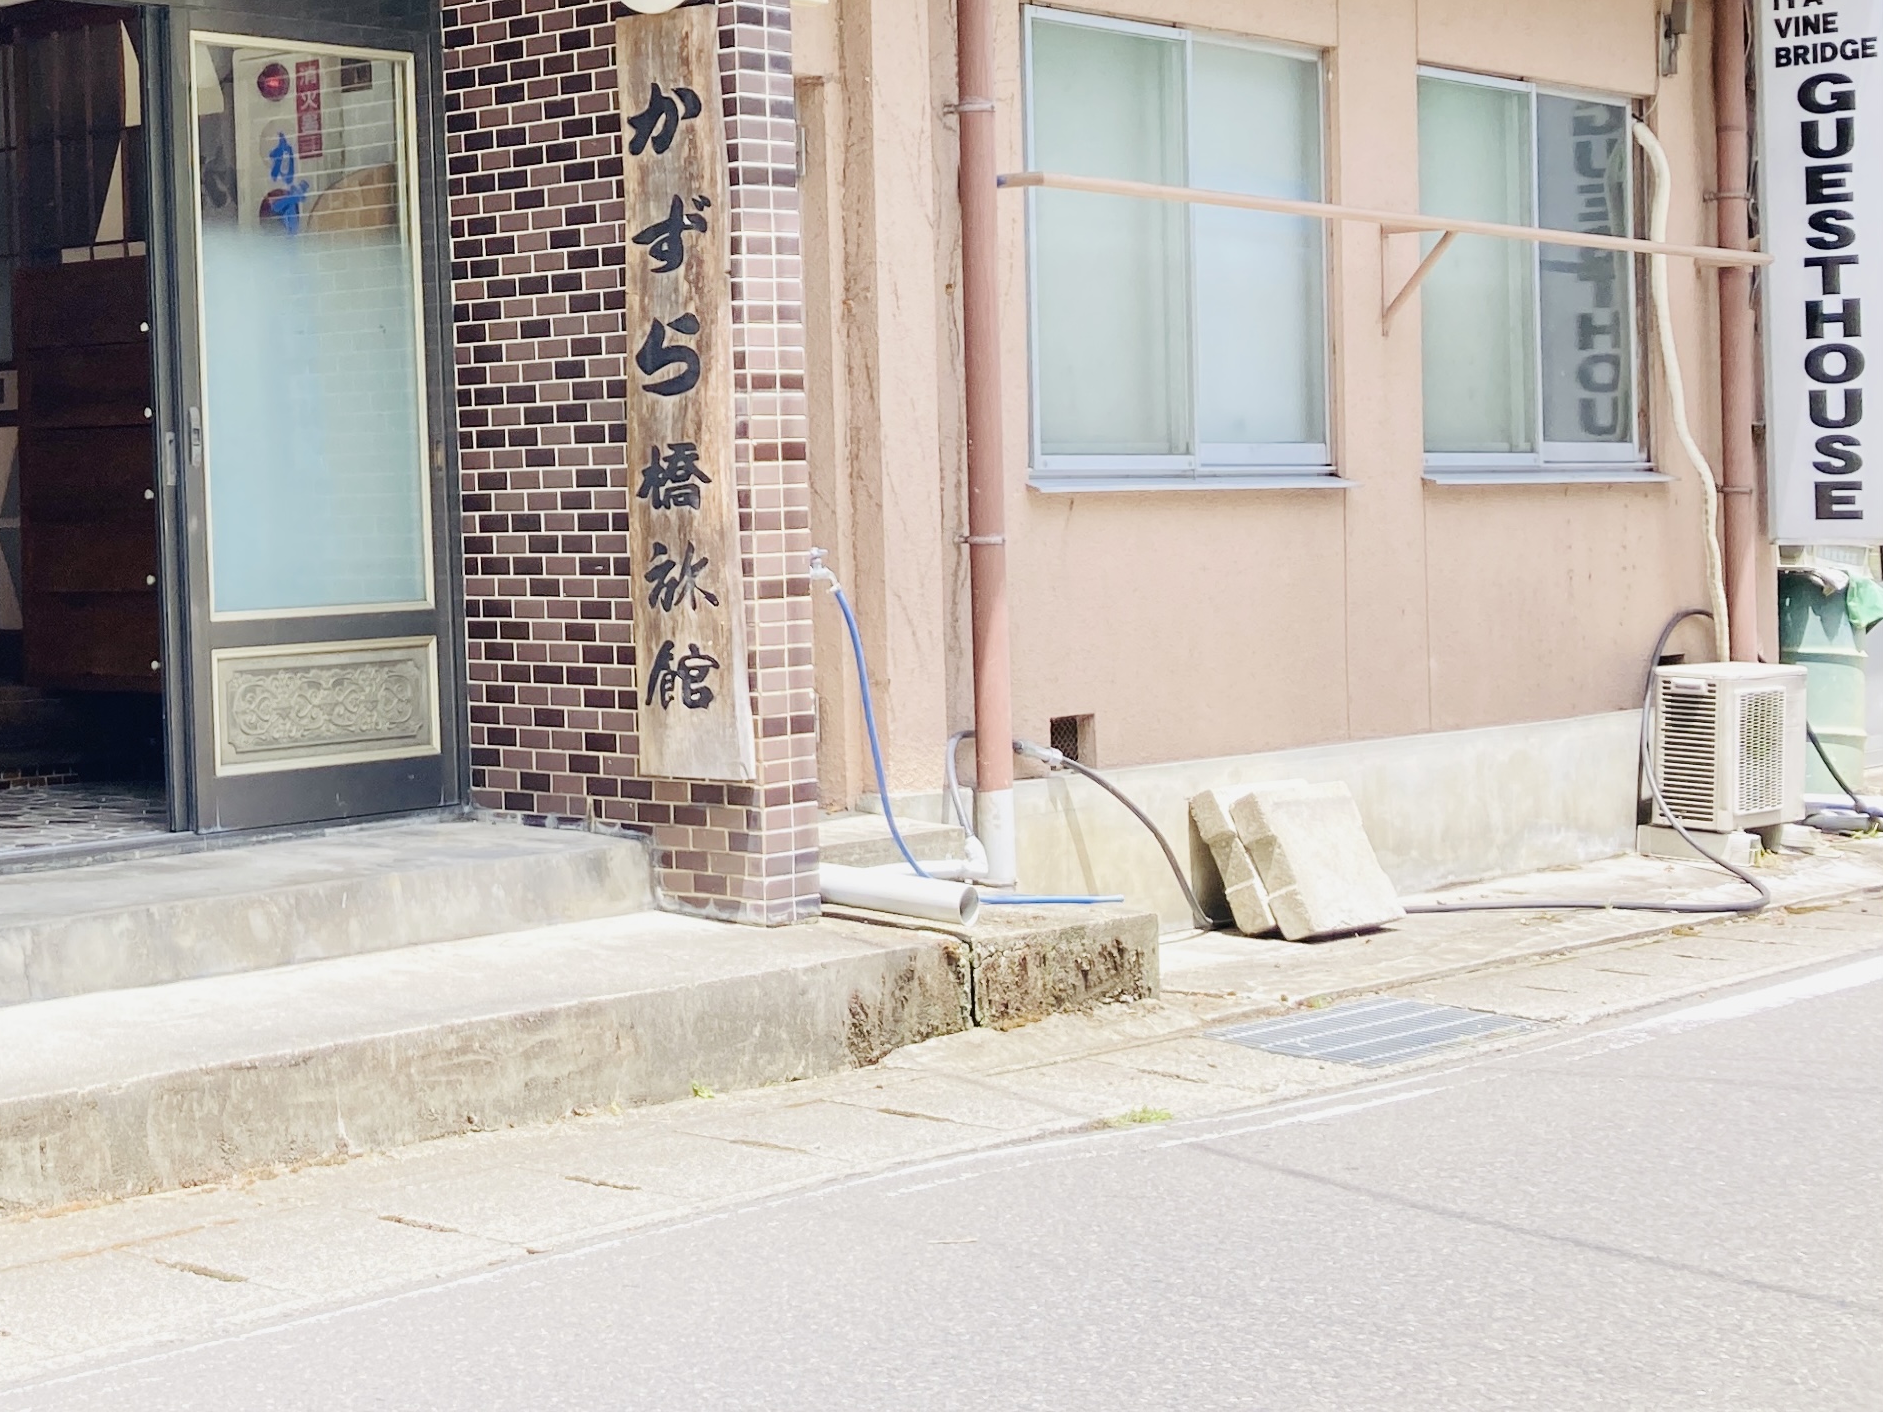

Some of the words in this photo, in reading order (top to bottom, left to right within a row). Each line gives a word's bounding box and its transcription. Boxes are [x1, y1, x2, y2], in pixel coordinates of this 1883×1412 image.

[1774, 12, 1838, 38] VINE
[1775, 36, 1878, 68] BRIDGE
[627, 82, 721, 709] かずら橋旅館
[1797, 73, 1865, 520] GUESTHOUSE
